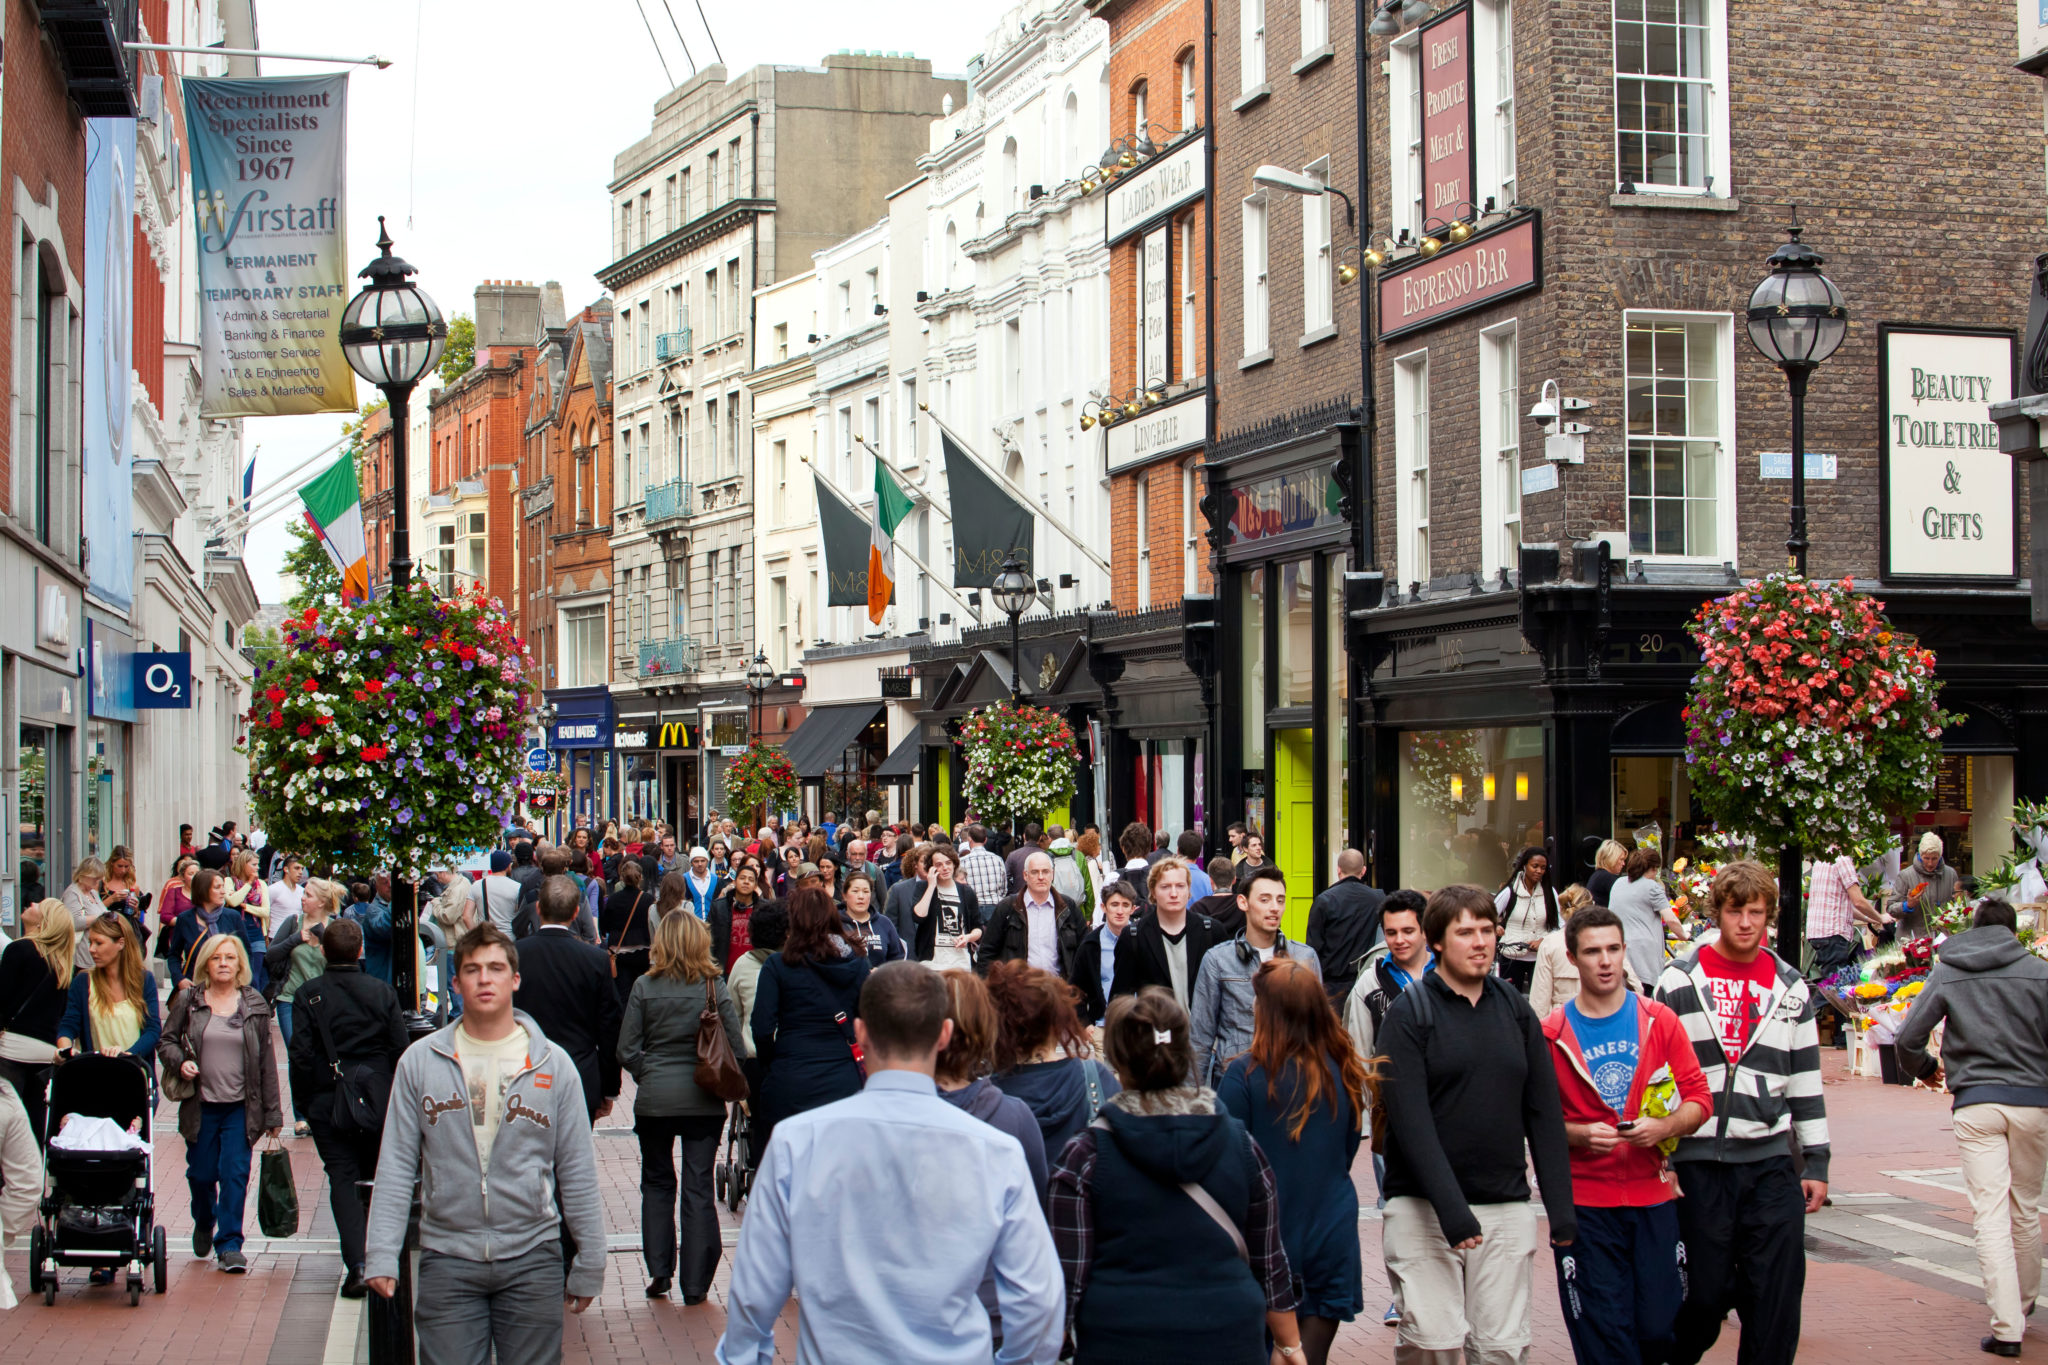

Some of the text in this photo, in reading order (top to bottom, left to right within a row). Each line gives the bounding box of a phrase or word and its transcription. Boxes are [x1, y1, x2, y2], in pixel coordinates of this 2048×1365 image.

[1431, 36, 1458, 71] FRESH
[197, 90, 330, 111] Recruitment
[1426, 79, 1465, 118] PRODUCE
[208, 112, 319, 136] Specialists
[236, 135, 292, 154] Since
[1429, 124, 1464, 163] MEAT &
[237, 157, 295, 181] 1967
[1121, 160, 1192, 225] LADIES WEAR
[1434, 178, 1460, 211] DAIRY
[225, 253, 317, 269] PERMANENT
[1147, 242, 1164, 268] FINE
[265, 270, 277, 284] &
[1402, 247, 1509, 317] ESPRESSO BAR
[205, 284, 344, 302] TEMPORARY STAFF
[1146, 278, 1166, 305] GIFTS
[223, 308, 330, 321] Admin & Secretarial
[224, 328, 325, 342] Banking & Finance
[1148, 316, 1163, 340] FOR
[226, 348, 321, 360] Customer Service
[1149, 354, 1163, 377] ALL
[244, 368, 252, 379] &
[256, 366, 320, 380] Engineering
[1910, 367, 1992, 402] BEAUTY
[228, 385, 324, 398] Sales & Marketing
[1134, 416, 1179, 454] LINGERIE
[1893, 414, 1999, 449] TOILETRIE
[1765, 466, 1788, 475] DUKE
[1825, 461, 1834, 473] 2
[1942, 460, 1961, 494] &
[1239, 490, 1262, 533] M&S
[1923, 506, 1983, 540] GIFTS
[831, 571, 869, 595] M&
[1440, 638, 1464, 668] M&S
[1640, 634, 1663, 653] 20
[885, 682, 908, 693] M&S
[614, 731, 648, 748] McDonald's
